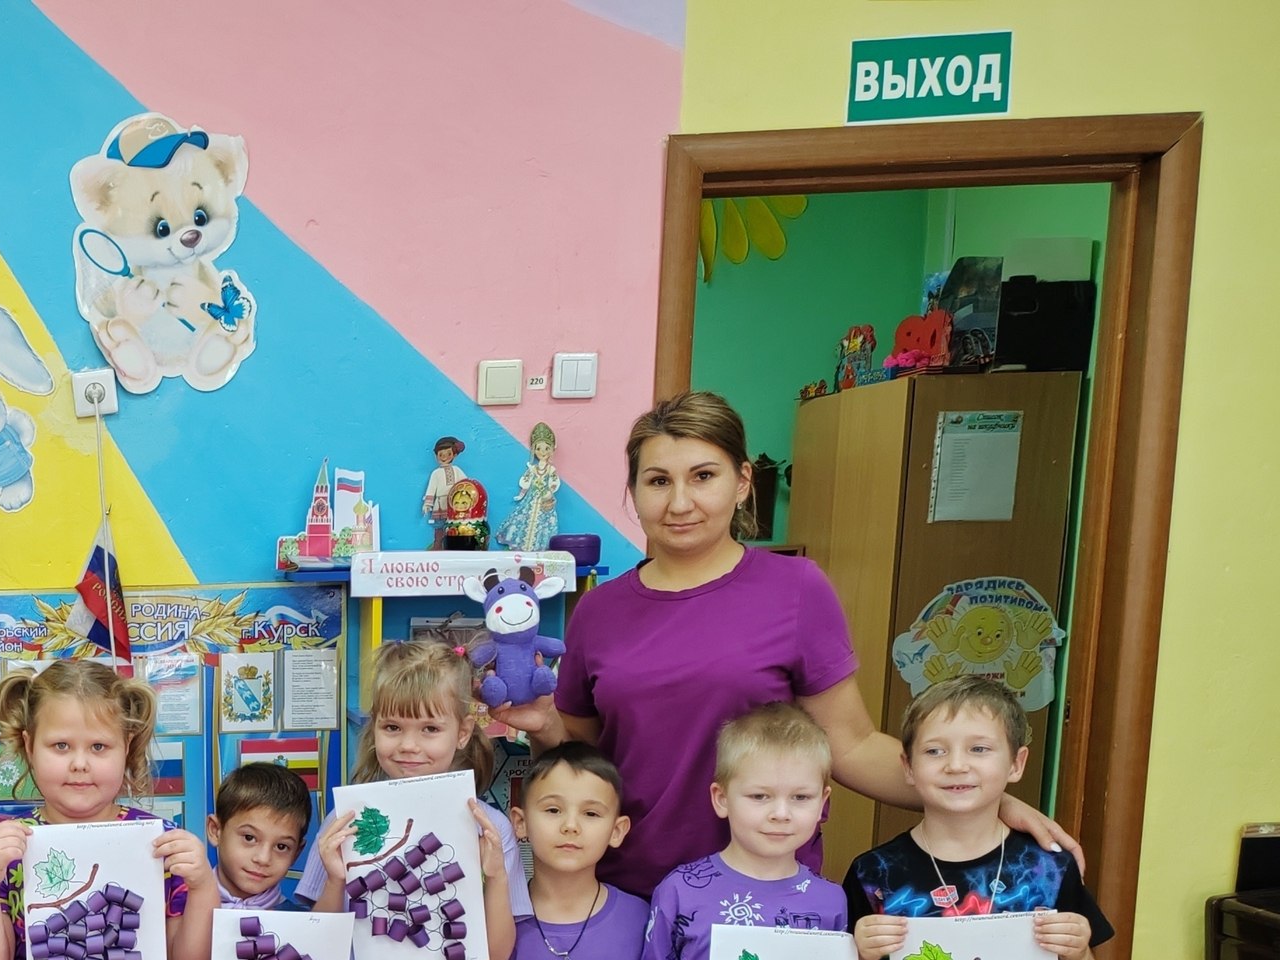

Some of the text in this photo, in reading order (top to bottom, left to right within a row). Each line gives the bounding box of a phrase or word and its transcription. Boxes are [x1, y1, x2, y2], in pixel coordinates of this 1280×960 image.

[854, 53, 1002, 103] ВЫХОД
[529, 377, 544, 385] 220
[361, 558, 440, 574] Я ЛЮБЛЮ
[386, 574, 429, 588] СВОЮ
[947, 580, 1025, 595] ЗАРЯДИСЬ
[131, 604, 210, 620] РОДИНА-
